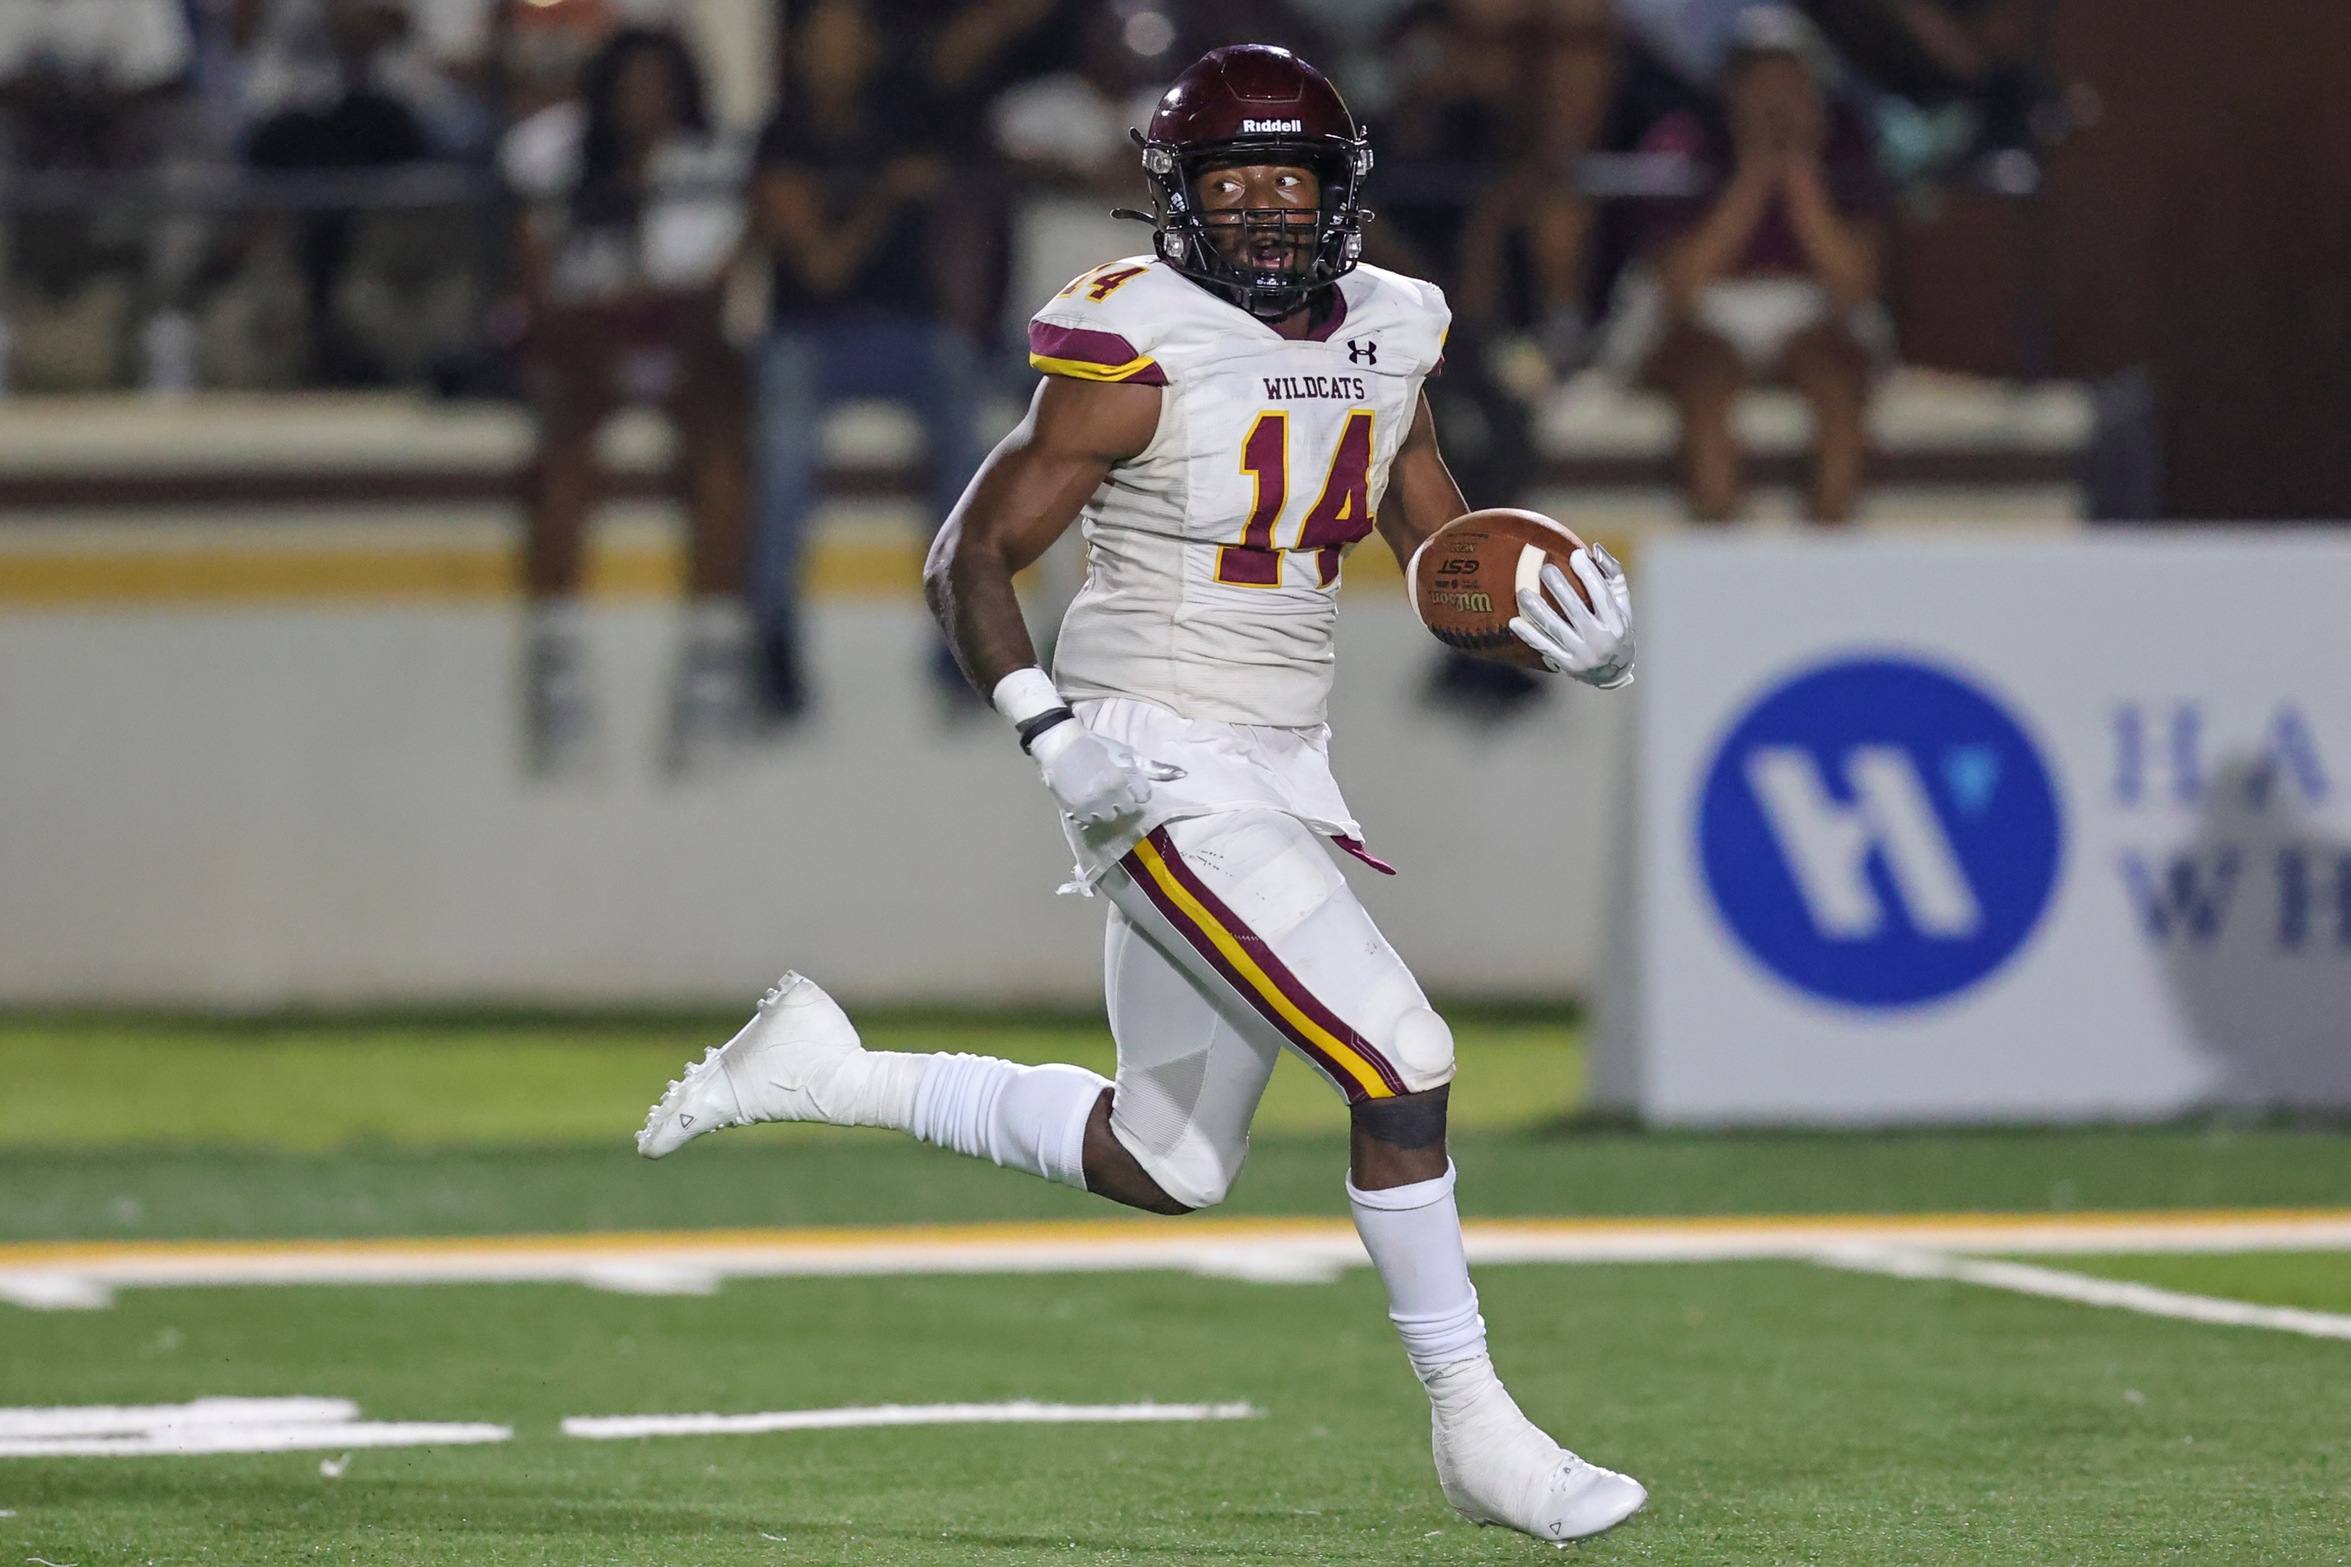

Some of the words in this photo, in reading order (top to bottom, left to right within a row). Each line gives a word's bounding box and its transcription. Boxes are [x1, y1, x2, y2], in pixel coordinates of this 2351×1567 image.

[1243, 119, 1302, 133] Riddell
[1263, 377, 1365, 400] WILDCATS
[1213, 409, 1376, 589] 14
[1437, 559, 1480, 575] GST
[1430, 589, 1493, 612] Wilson
